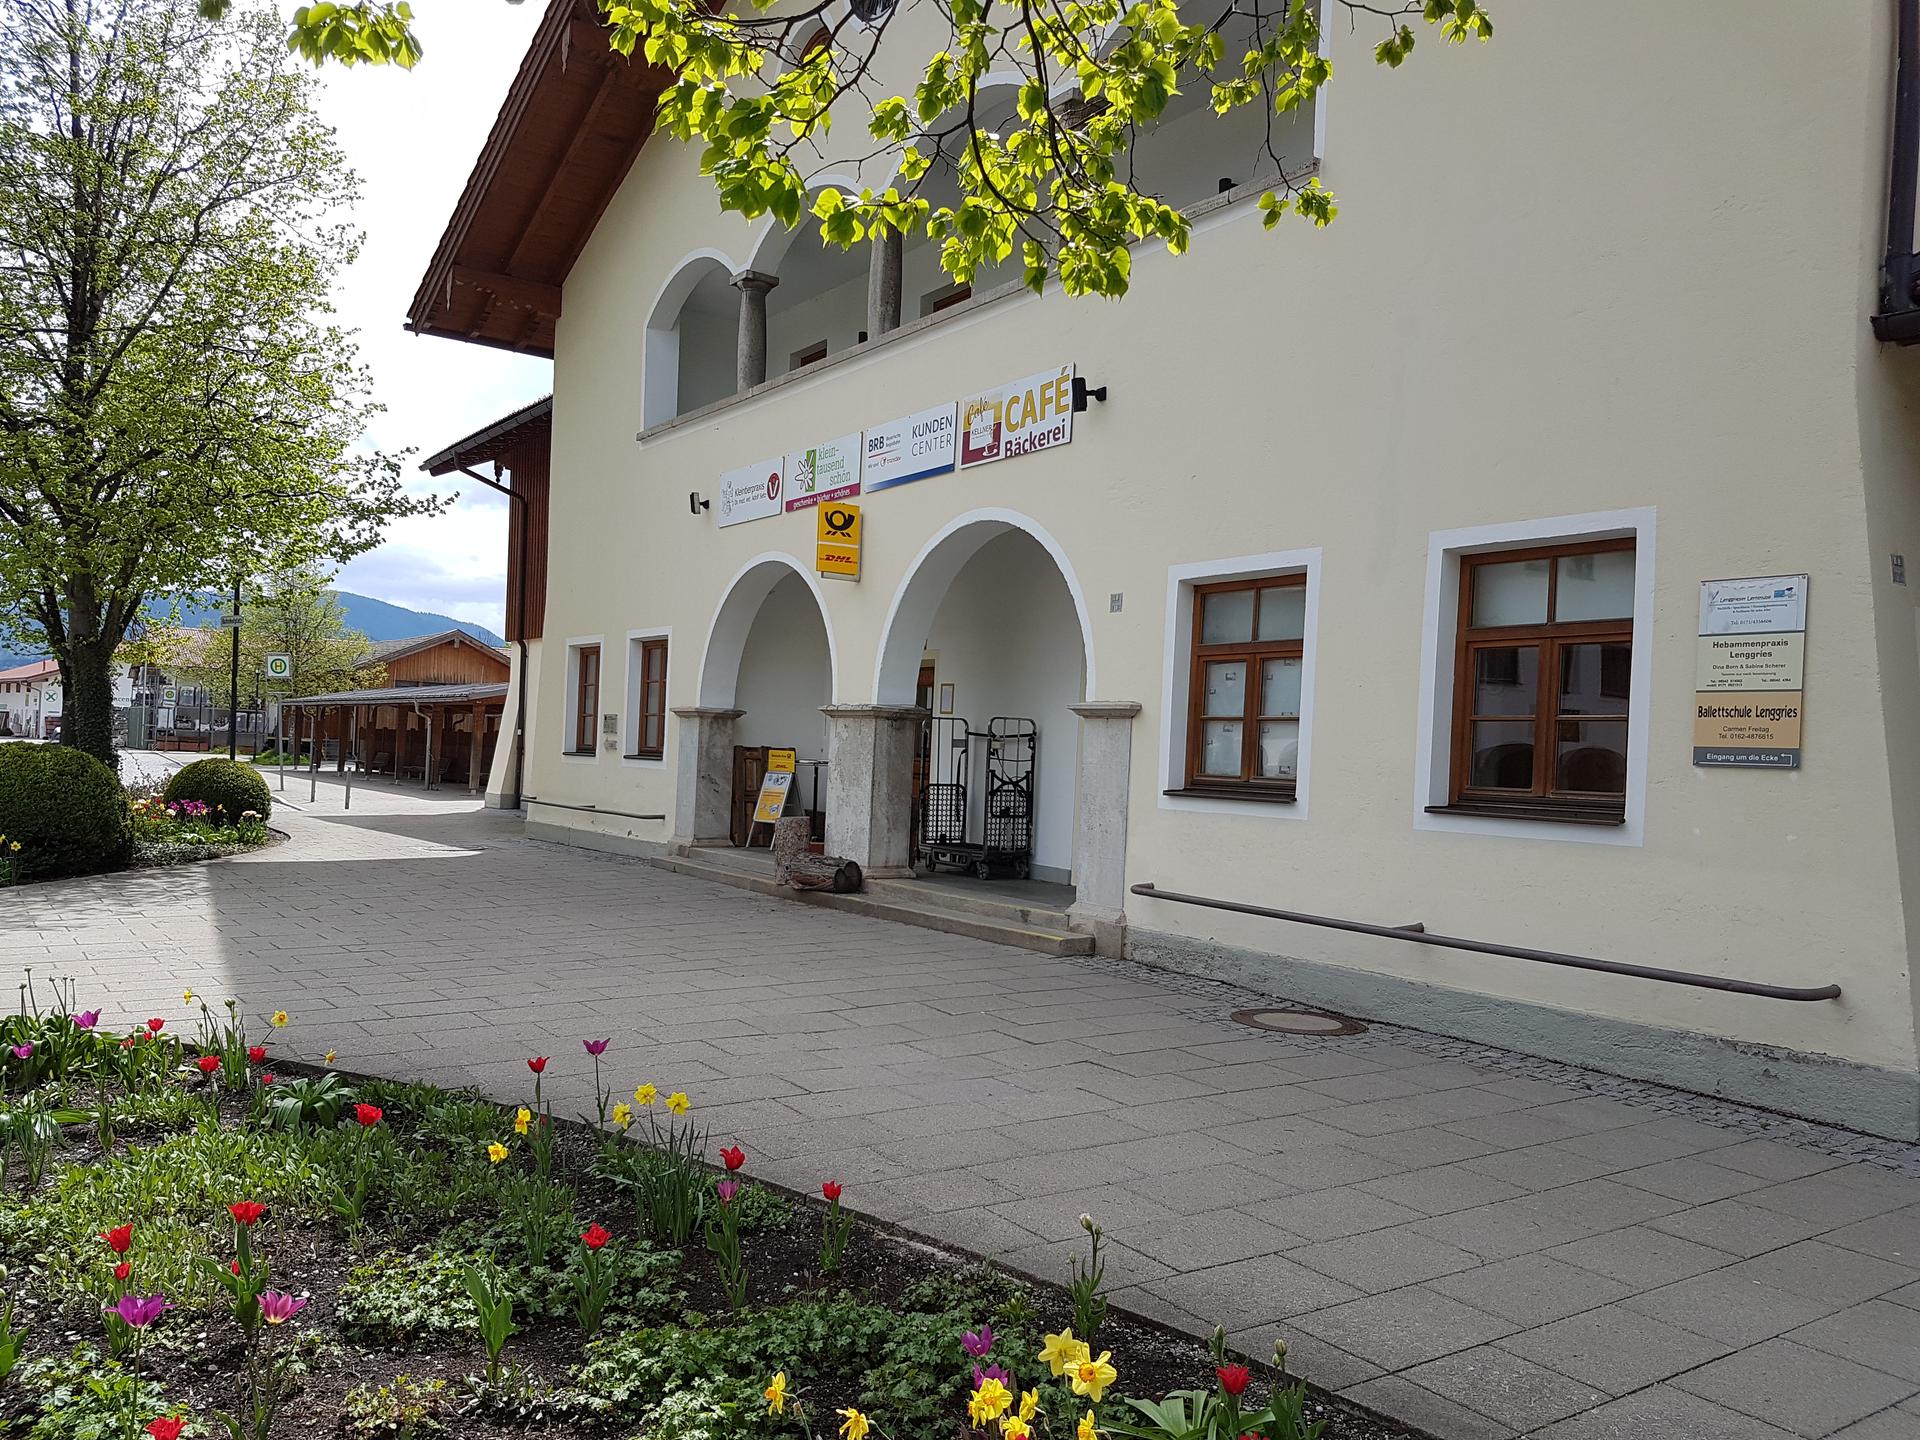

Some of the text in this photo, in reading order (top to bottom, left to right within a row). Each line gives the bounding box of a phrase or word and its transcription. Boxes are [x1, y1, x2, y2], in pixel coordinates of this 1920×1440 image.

[1004, 365, 1070, 433] CAFÉ
[911, 414, 953, 439] KUNDEN
[868, 436, 885, 452] BRB
[911, 433, 952, 457] CENTER
[1004, 418, 1066, 459] Bäckerei
[818, 443, 839, 460] klein-
[817, 456, 845, 475] tausend
[829, 470, 851, 486] schön
[824, 554, 853, 564] DHL
[1712, 639, 1789, 649] Hebammenpraxis
[1729, 650, 1773, 660] Lenggries
[274, 661, 282, 671] H
[1697, 705, 1798, 721] Ballettschule Lenggries
[1748, 725, 1770, 733] Freitag
[1706, 752, 1735, 761] Eingang
[1761, 753, 1779, 761] Ecke
